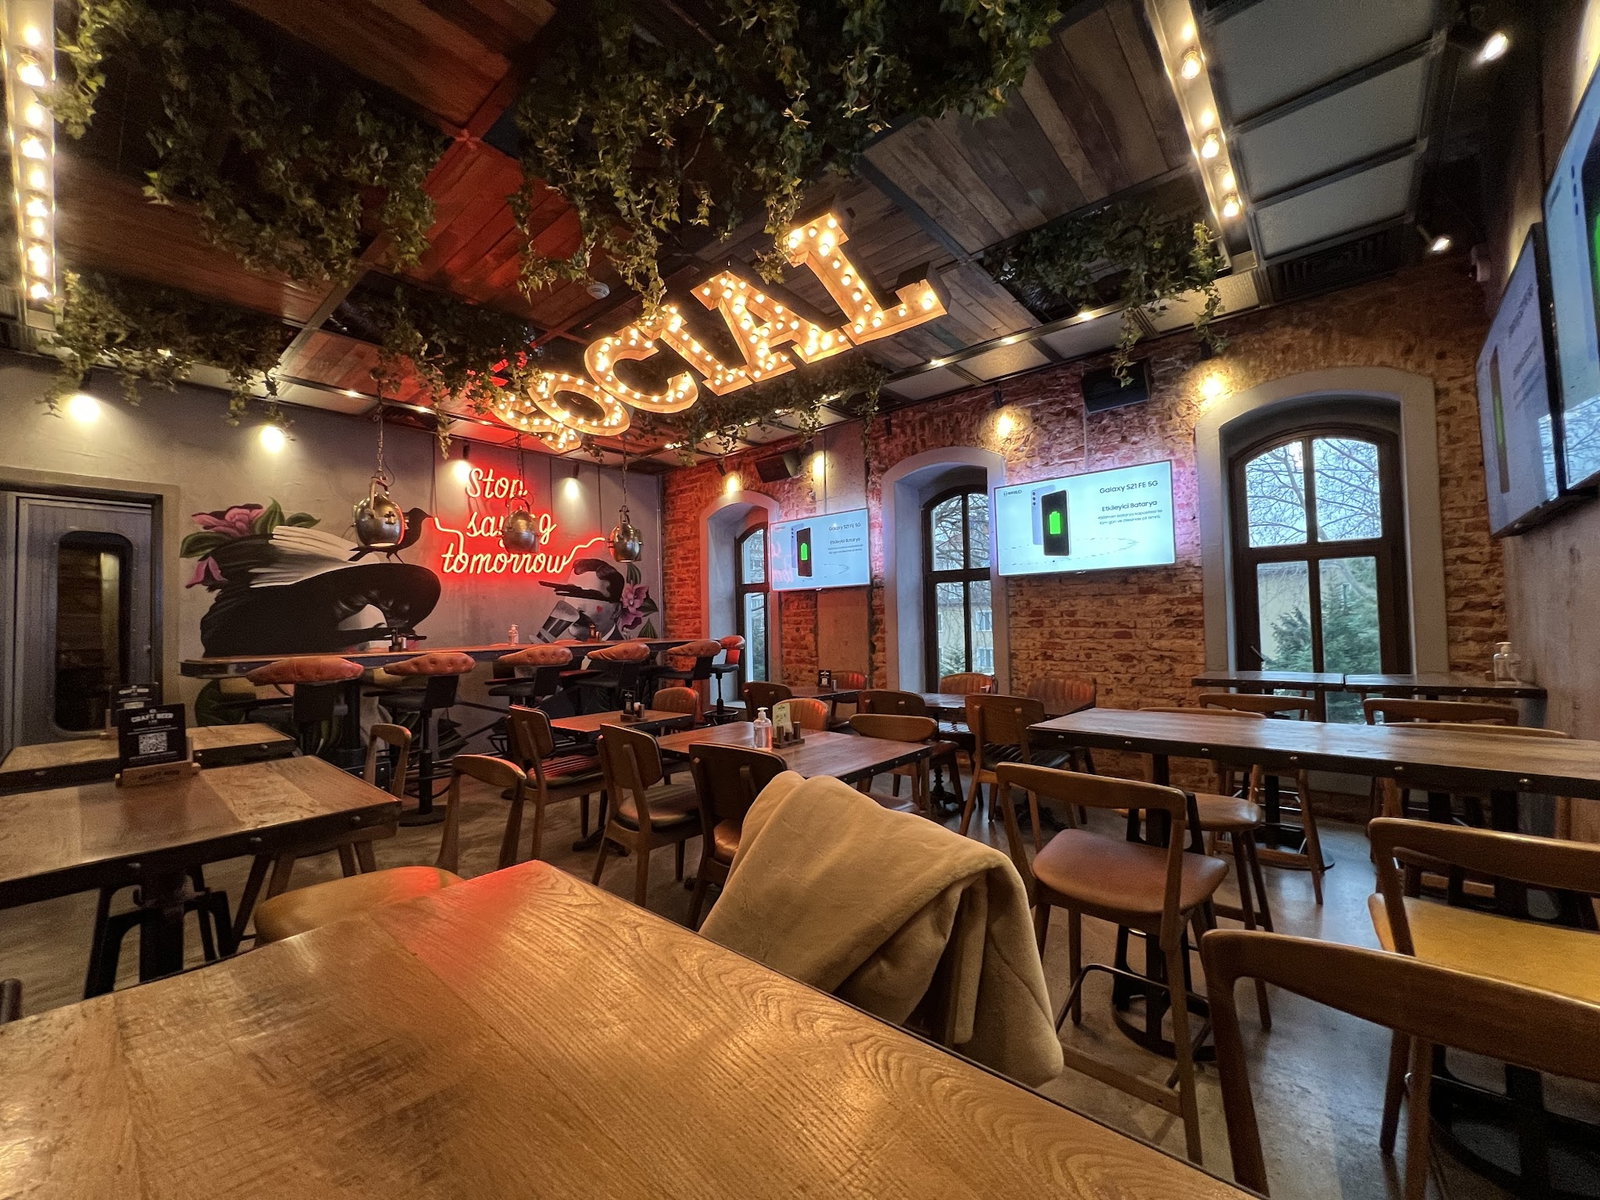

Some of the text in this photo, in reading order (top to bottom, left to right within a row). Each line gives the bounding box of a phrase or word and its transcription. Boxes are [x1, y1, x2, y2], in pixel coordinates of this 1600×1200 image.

[489, 213, 948, 454] SOCIAL
[1099, 486, 1125, 494] Galaxy
[441, 543, 567, 574] tomorrow
